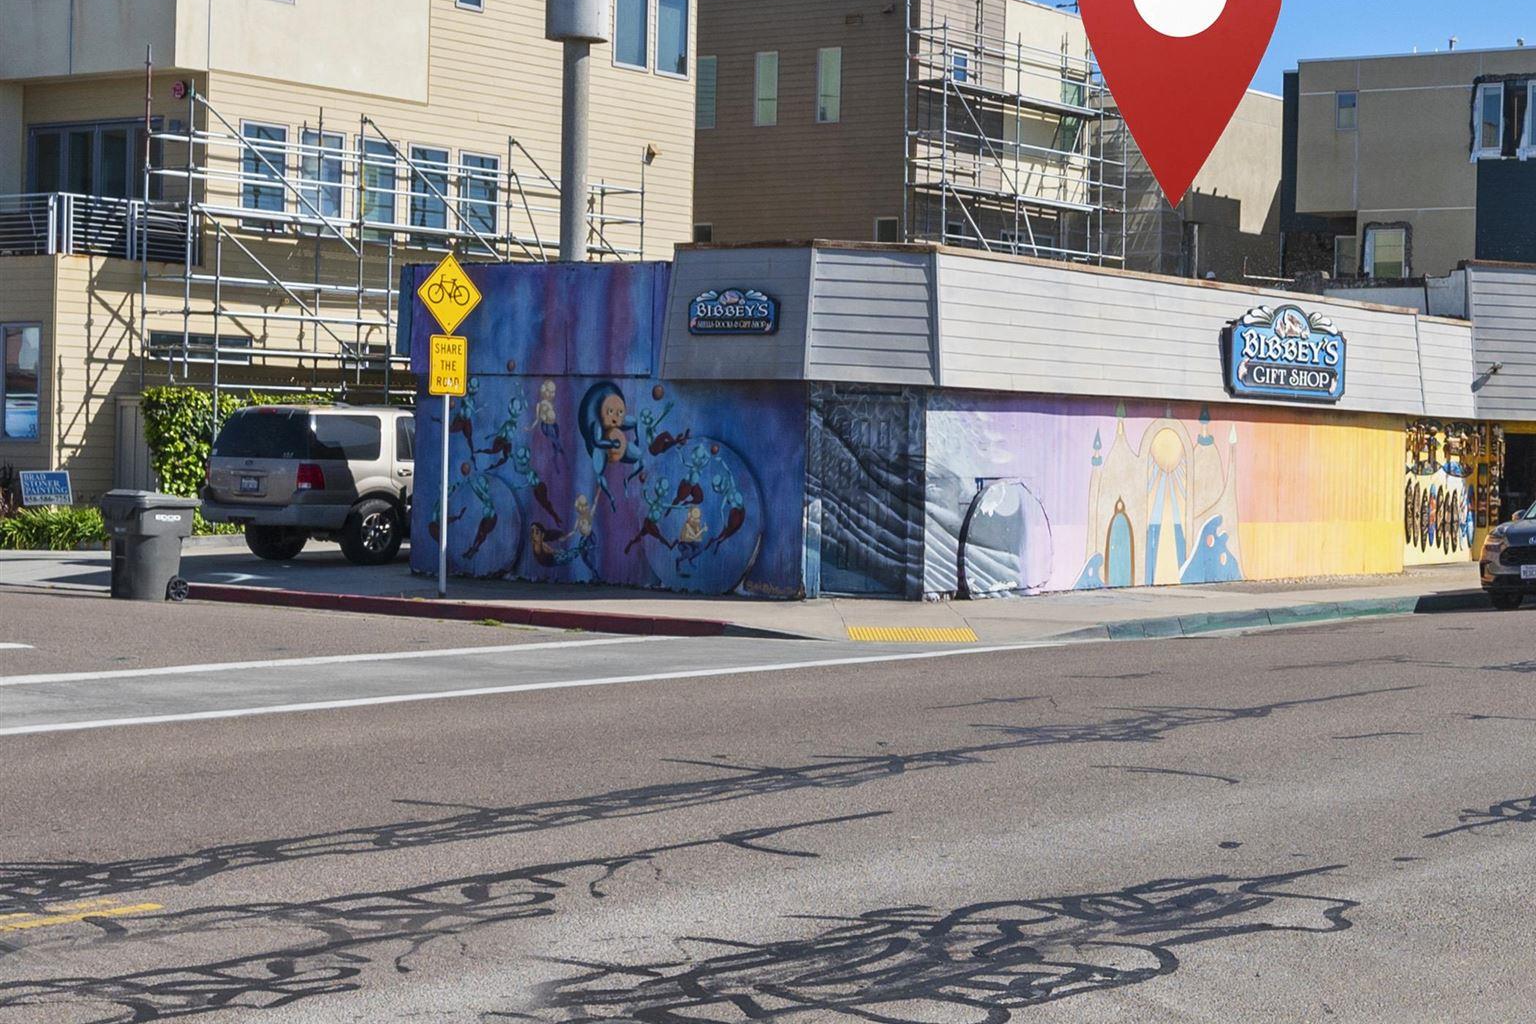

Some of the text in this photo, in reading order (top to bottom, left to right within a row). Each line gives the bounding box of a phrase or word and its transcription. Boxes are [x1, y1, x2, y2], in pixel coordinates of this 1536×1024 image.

[697, 303, 768, 317] BIBBEY'S
[435, 342, 462, 355] SHARE
[1242, 329, 1339, 365] BIBBEY'S
[441, 360, 456, 371] THE
[436, 376, 459, 387] ROAD
[1253, 366, 1330, 388] GIFT SHOP
